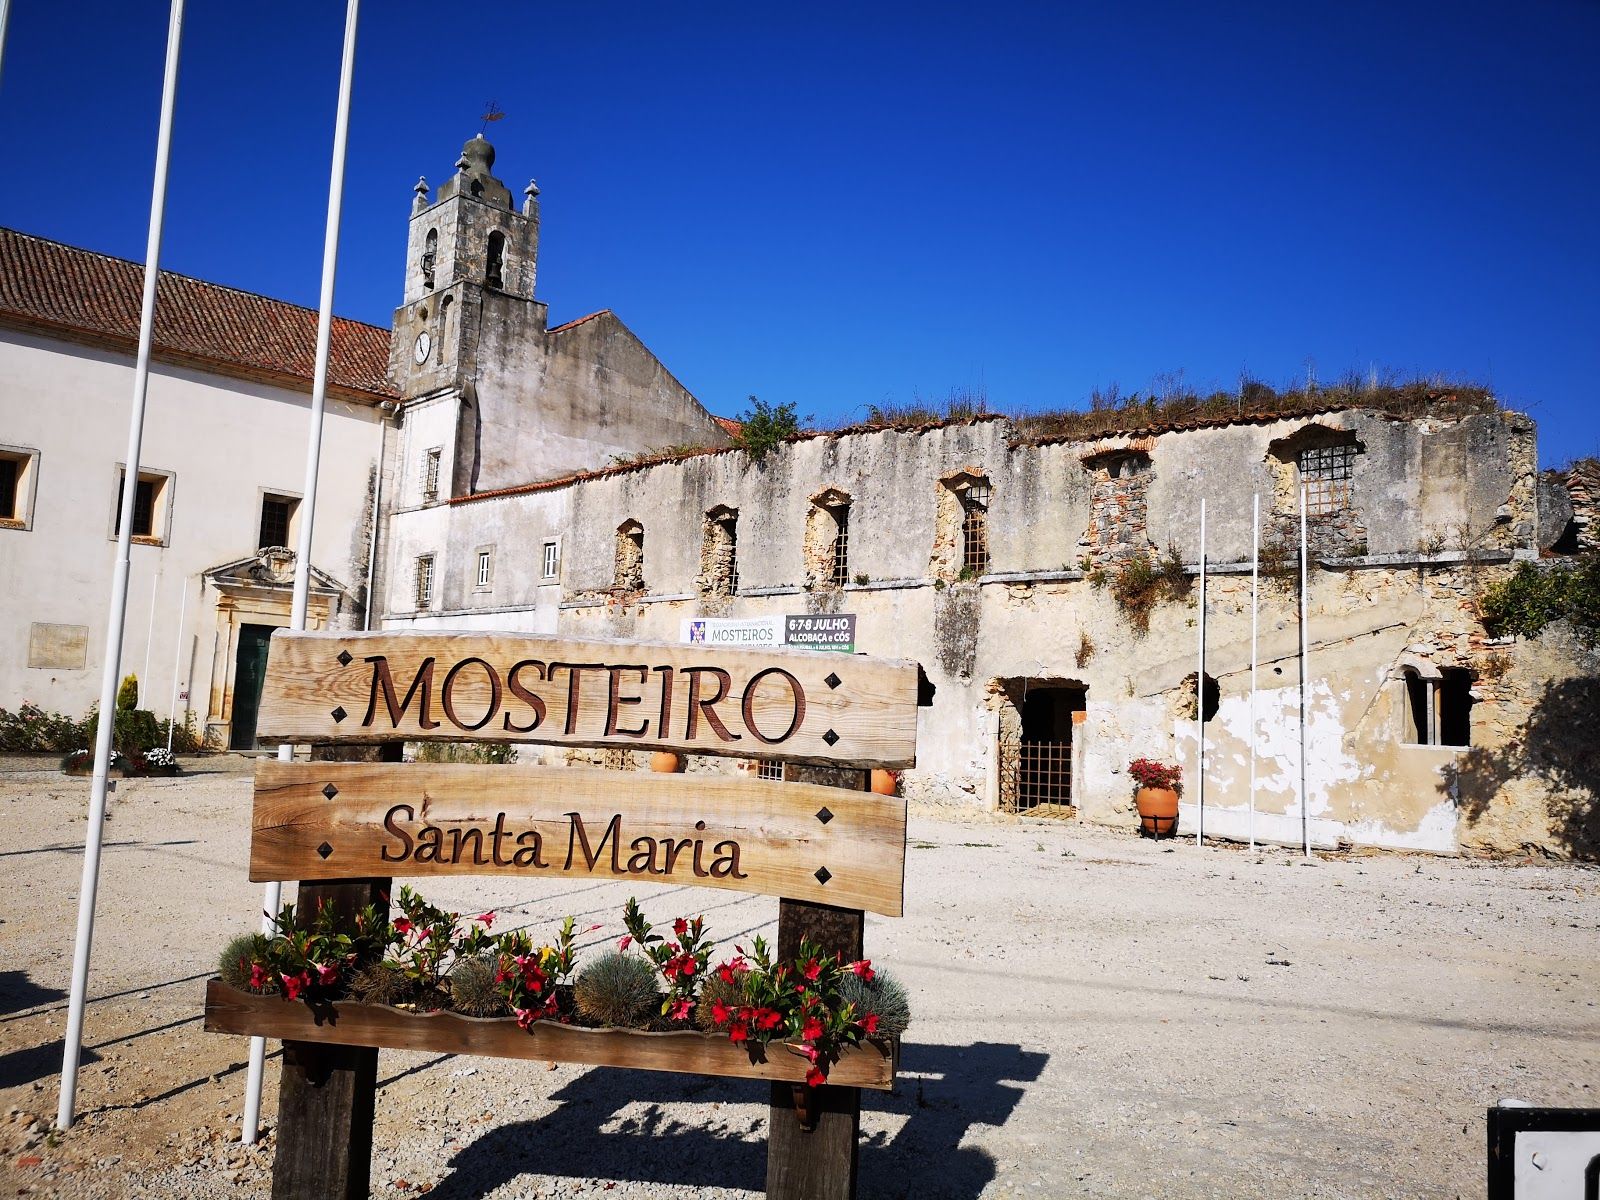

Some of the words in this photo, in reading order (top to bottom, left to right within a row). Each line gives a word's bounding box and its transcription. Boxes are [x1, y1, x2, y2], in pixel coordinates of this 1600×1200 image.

[813, 618, 849, 630] JULHO
[712, 629, 773, 641] MOSTEIROS
[789, 633, 827, 643] ALCOBAÇA
[834, 631, 850, 642] CÓS
[362, 656, 807, 744] MOSTEIRO
[382, 804, 549, 868] Santa
[563, 811, 749, 879] Maria
